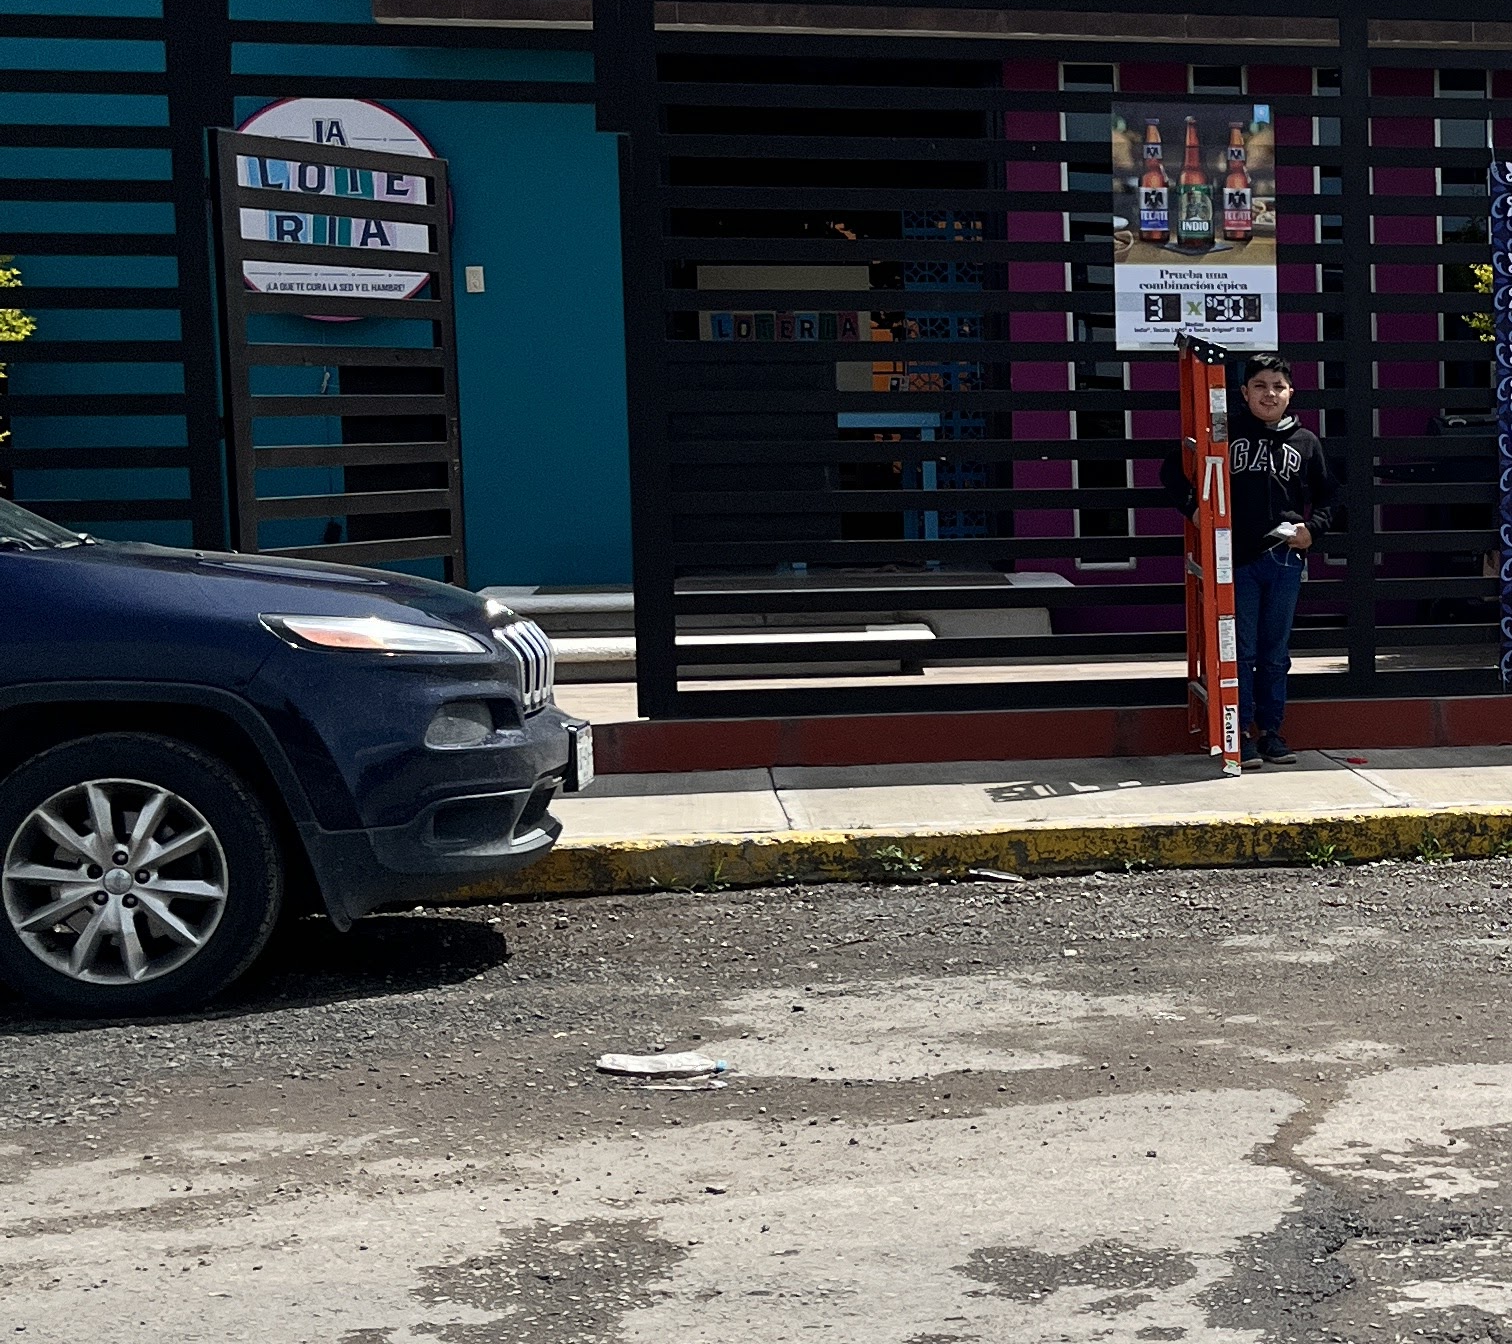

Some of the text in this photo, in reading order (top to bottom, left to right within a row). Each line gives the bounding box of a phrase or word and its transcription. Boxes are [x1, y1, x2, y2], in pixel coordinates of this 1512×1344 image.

[1182, 221, 1209, 231] INDIO
[1160, 269, 1228, 280] Prueba una
[280, 283, 295, 292] QUE
[296, 283, 305, 292] TE
[306, 283, 327, 292] CURA
[328, 283, 338, 292] LA
[339, 283, 355, 292] SED
[361, 284, 370, 292] EL
[371, 284, 406, 293] HAMBRE!
[1139, 280, 1248, 293] combinación épica
[1148, 295, 1163, 321] 3
[717, 317, 858, 339] LOTERIA
[1229, 438, 1302, 481] GAP
